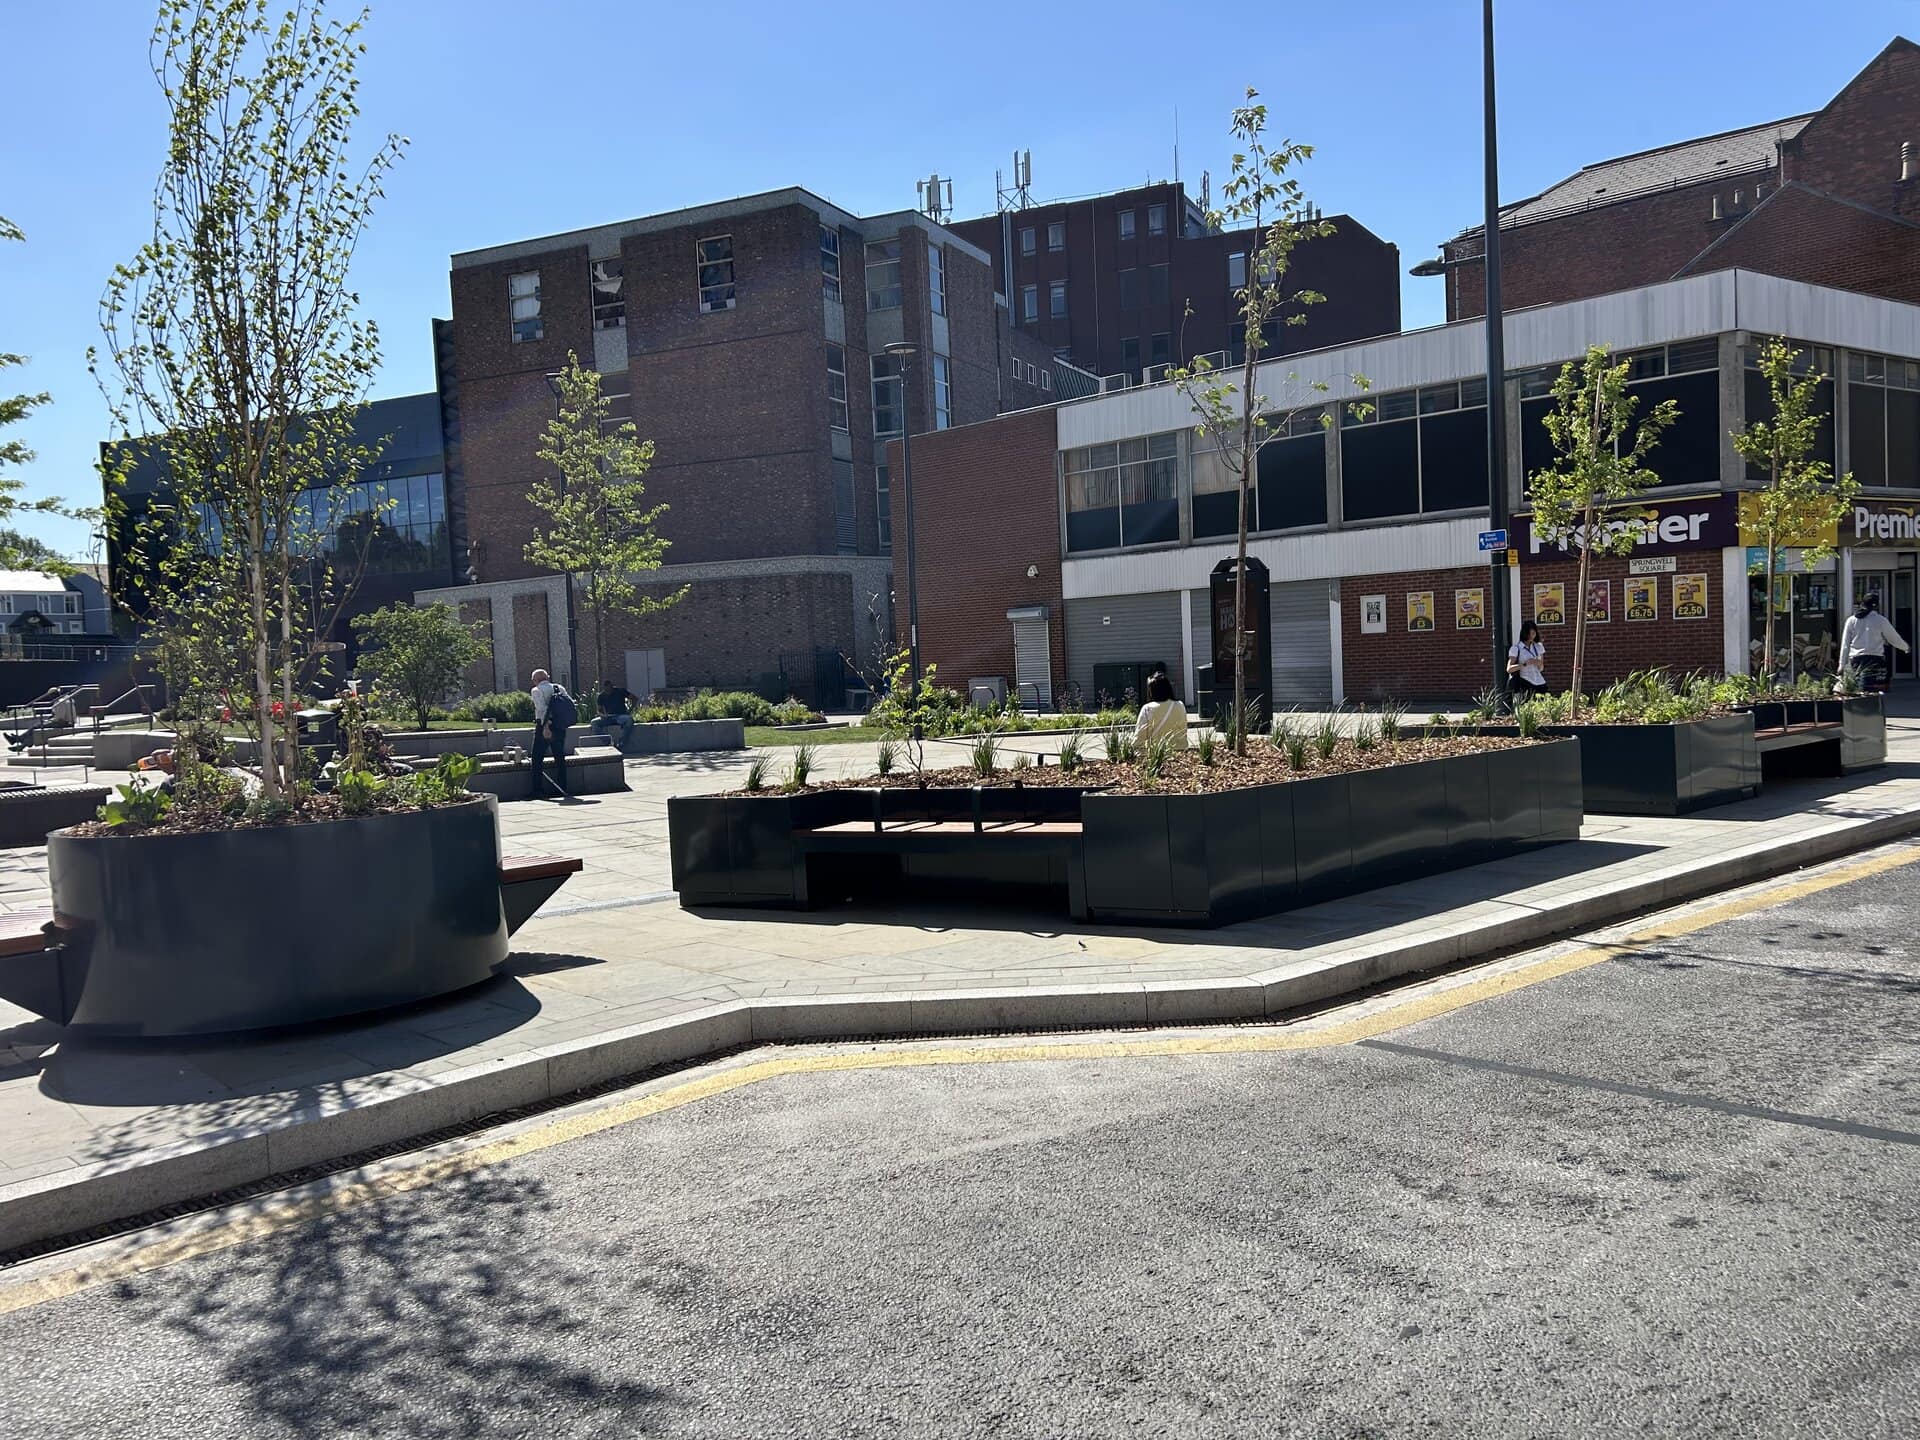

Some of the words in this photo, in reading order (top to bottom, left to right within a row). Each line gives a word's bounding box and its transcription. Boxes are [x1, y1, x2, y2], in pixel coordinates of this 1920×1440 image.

[1631, 557, 1673, 567] SPRINGWELL
[1640, 563, 1667, 573] SQUARE
[1678, 606, 1703, 616] £2.50
